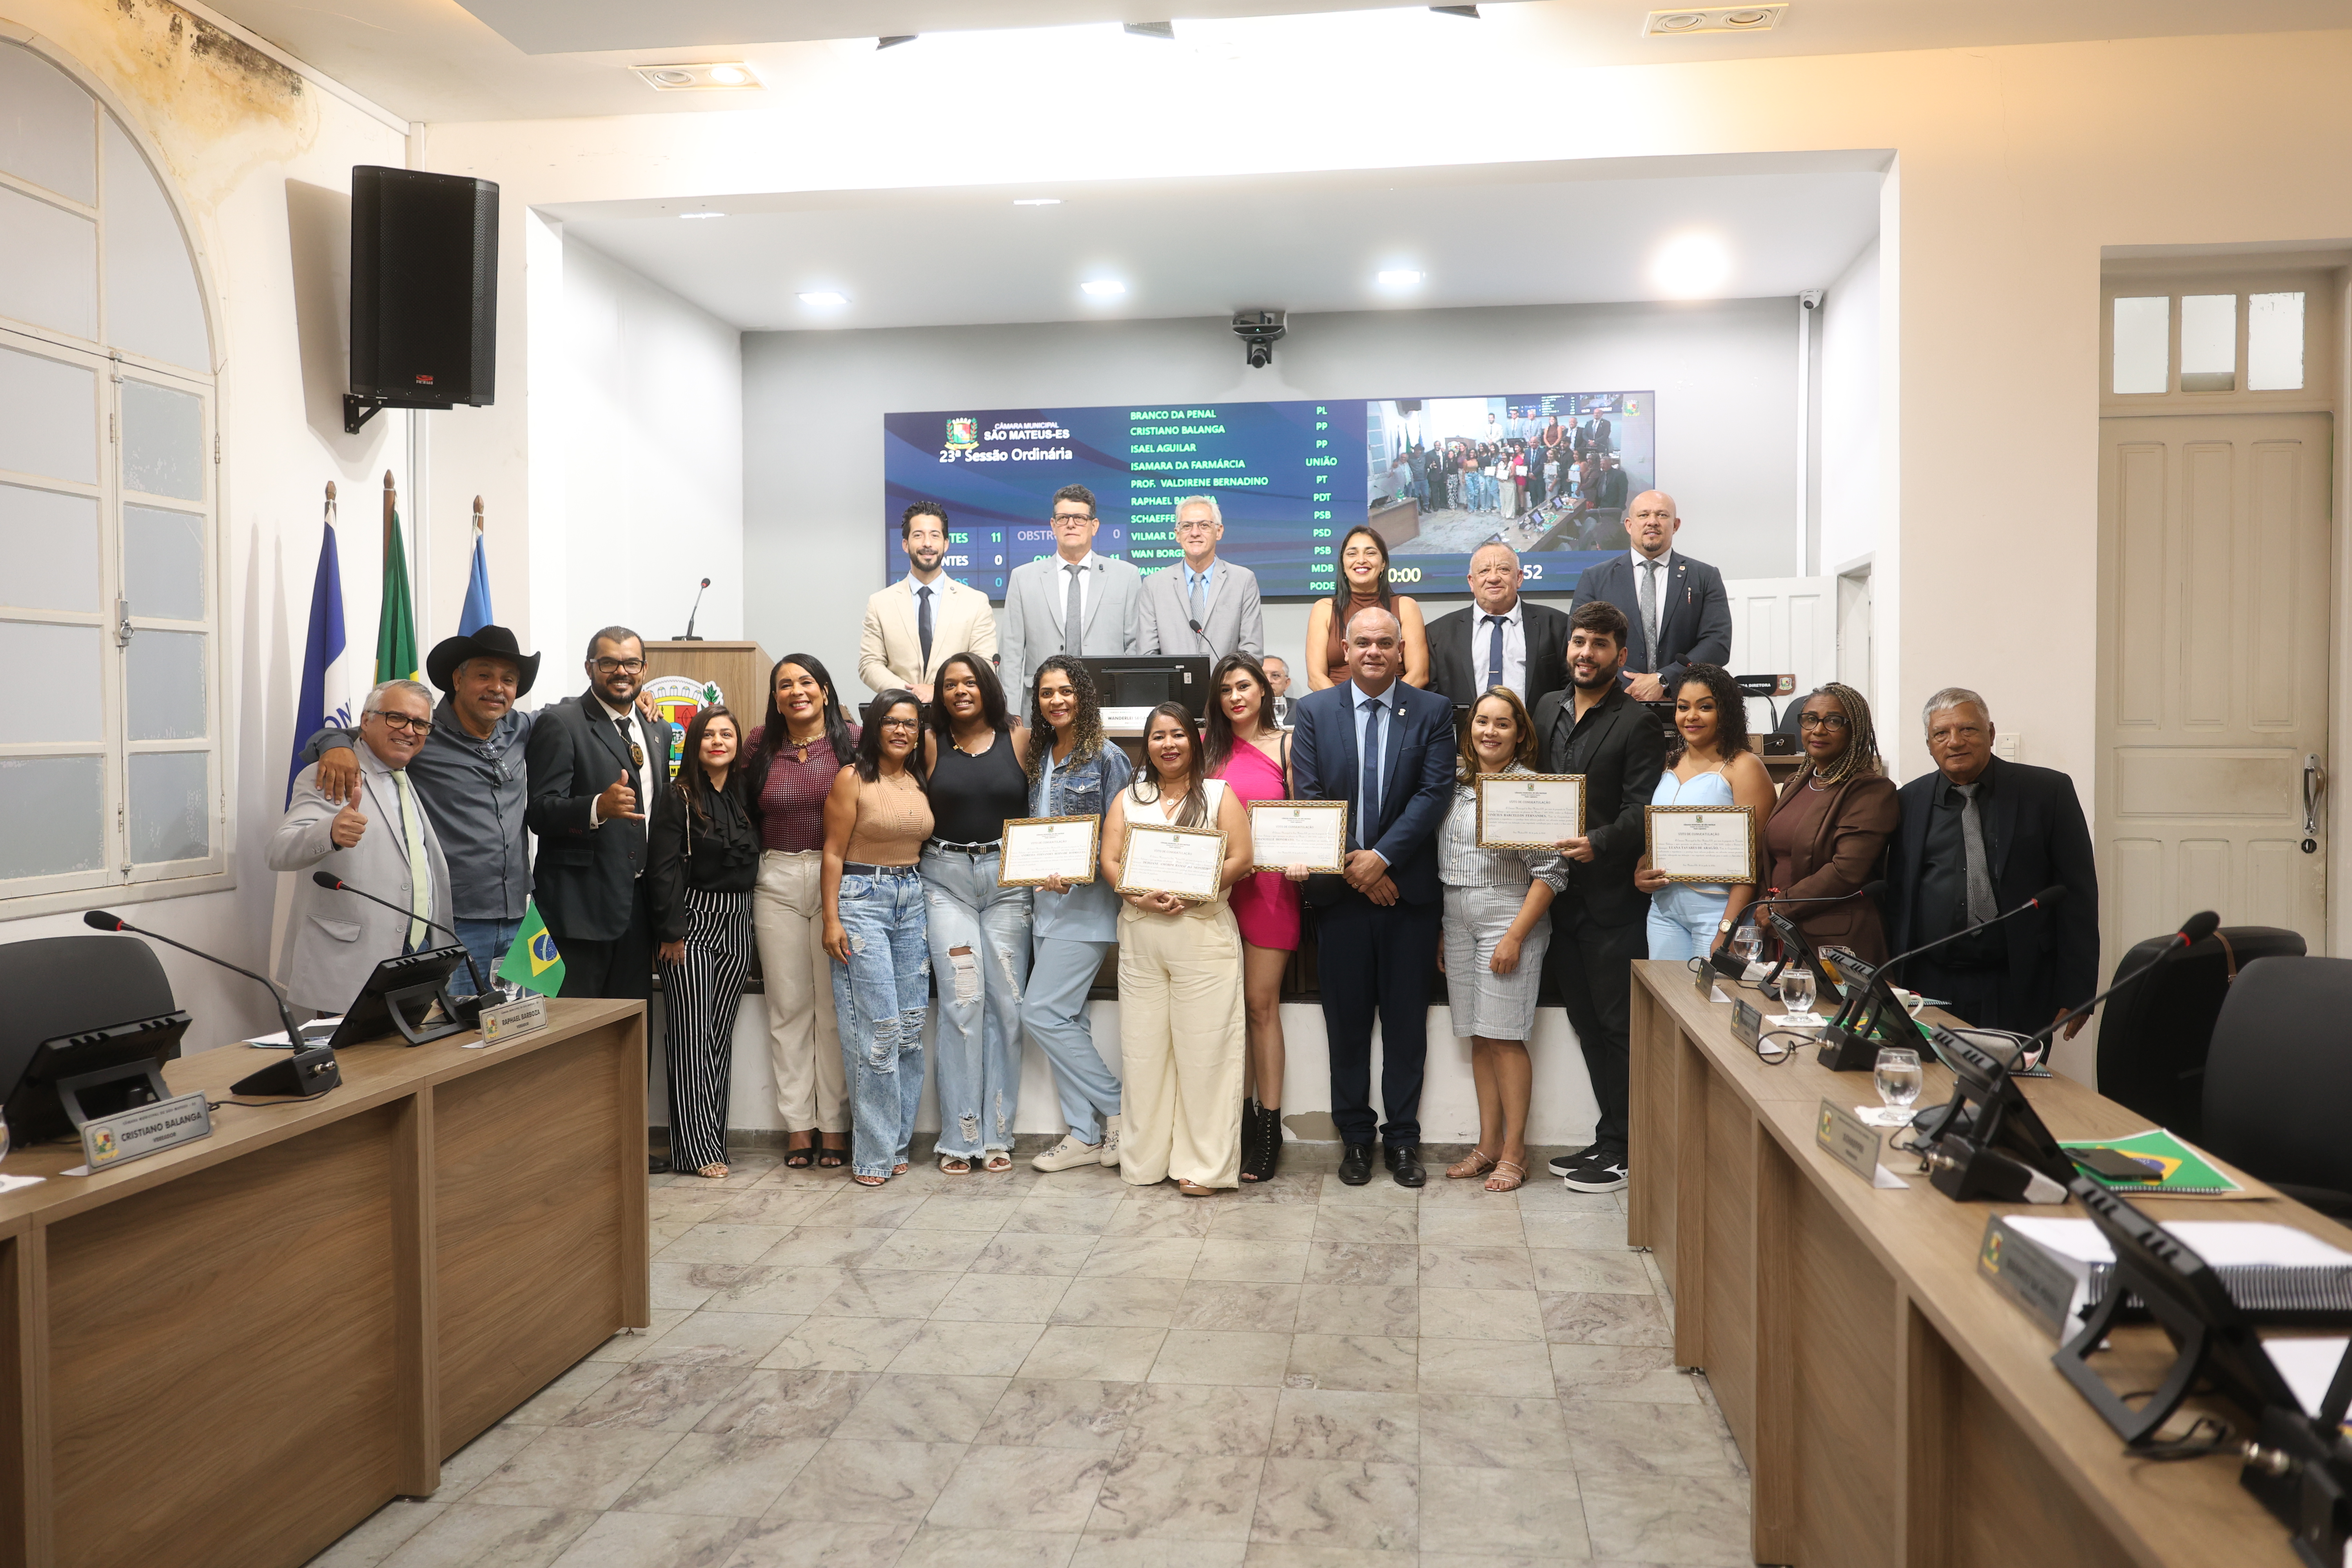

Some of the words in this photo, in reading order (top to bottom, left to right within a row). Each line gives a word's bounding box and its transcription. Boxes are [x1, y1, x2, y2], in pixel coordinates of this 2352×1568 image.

[1130, 411, 1169, 420] BRANCO
[1171, 411, 1184, 419] DA
[1187, 410, 1216, 418] PENAL
[1316, 406, 1327, 415] PL
[1130, 426, 1179, 436] CRISTIANO
[1181, 425, 1225, 434] BALANGA
[1316, 422, 1327, 431] PP
[984, 429, 1007, 441] SÃO
[1009, 429, 1070, 440] MATEUS-ES
[1131, 444, 1154, 453] ISAEL
[1156, 443, 1196, 453] AGUILAR
[1316, 439, 1327, 448] PP
[965, 448, 1008, 462] Sessão
[1011, 447, 1073, 461] Ordinária
[1131, 461, 1173, 471] ISAMARA
[1175, 461, 1189, 470] DA
[1191, 459, 1245, 469] FARMÁRCIA
[1305, 456, 1338, 466] UNIÃO
[1131, 479, 1156, 488] PROF.
[1160, 478, 1211, 488] VALDIRENE
[1213, 477, 1269, 486] BERNADINO
[1316, 475, 1327, 484] PT
[1131, 497, 1172, 506] RAPHAEL
[1313, 493, 1331, 501] PDT
[1131, 514, 1176, 523] SCHAEFFE
[1314, 511, 1331, 519] PSB
[991, 532, 1002, 543] 11
[1017, 530, 1057, 541] OBSTR
[1113, 529, 1120, 539] 0
[1131, 532, 1167, 541] VILMAR
[1169, 532, 1176, 540] D
[1313, 528, 1331, 537] PSD
[1131, 550, 1154, 558] WAN
[1156, 549, 1185, 558] BORGE
[1314, 546, 1331, 555] PSB
[995, 555, 1003, 565] 0
[1311, 564, 1334, 573] MDB
[995, 577, 1003, 587] 0
[1310, 581, 1335, 591] PODE
[502, 1015, 521, 1026] RAPHAEL
[521, 1009, 540, 1020] BARBOZA
[121, 1123, 163, 1142] CRISTIANO
[165, 1112, 203, 1129] BALANGA
